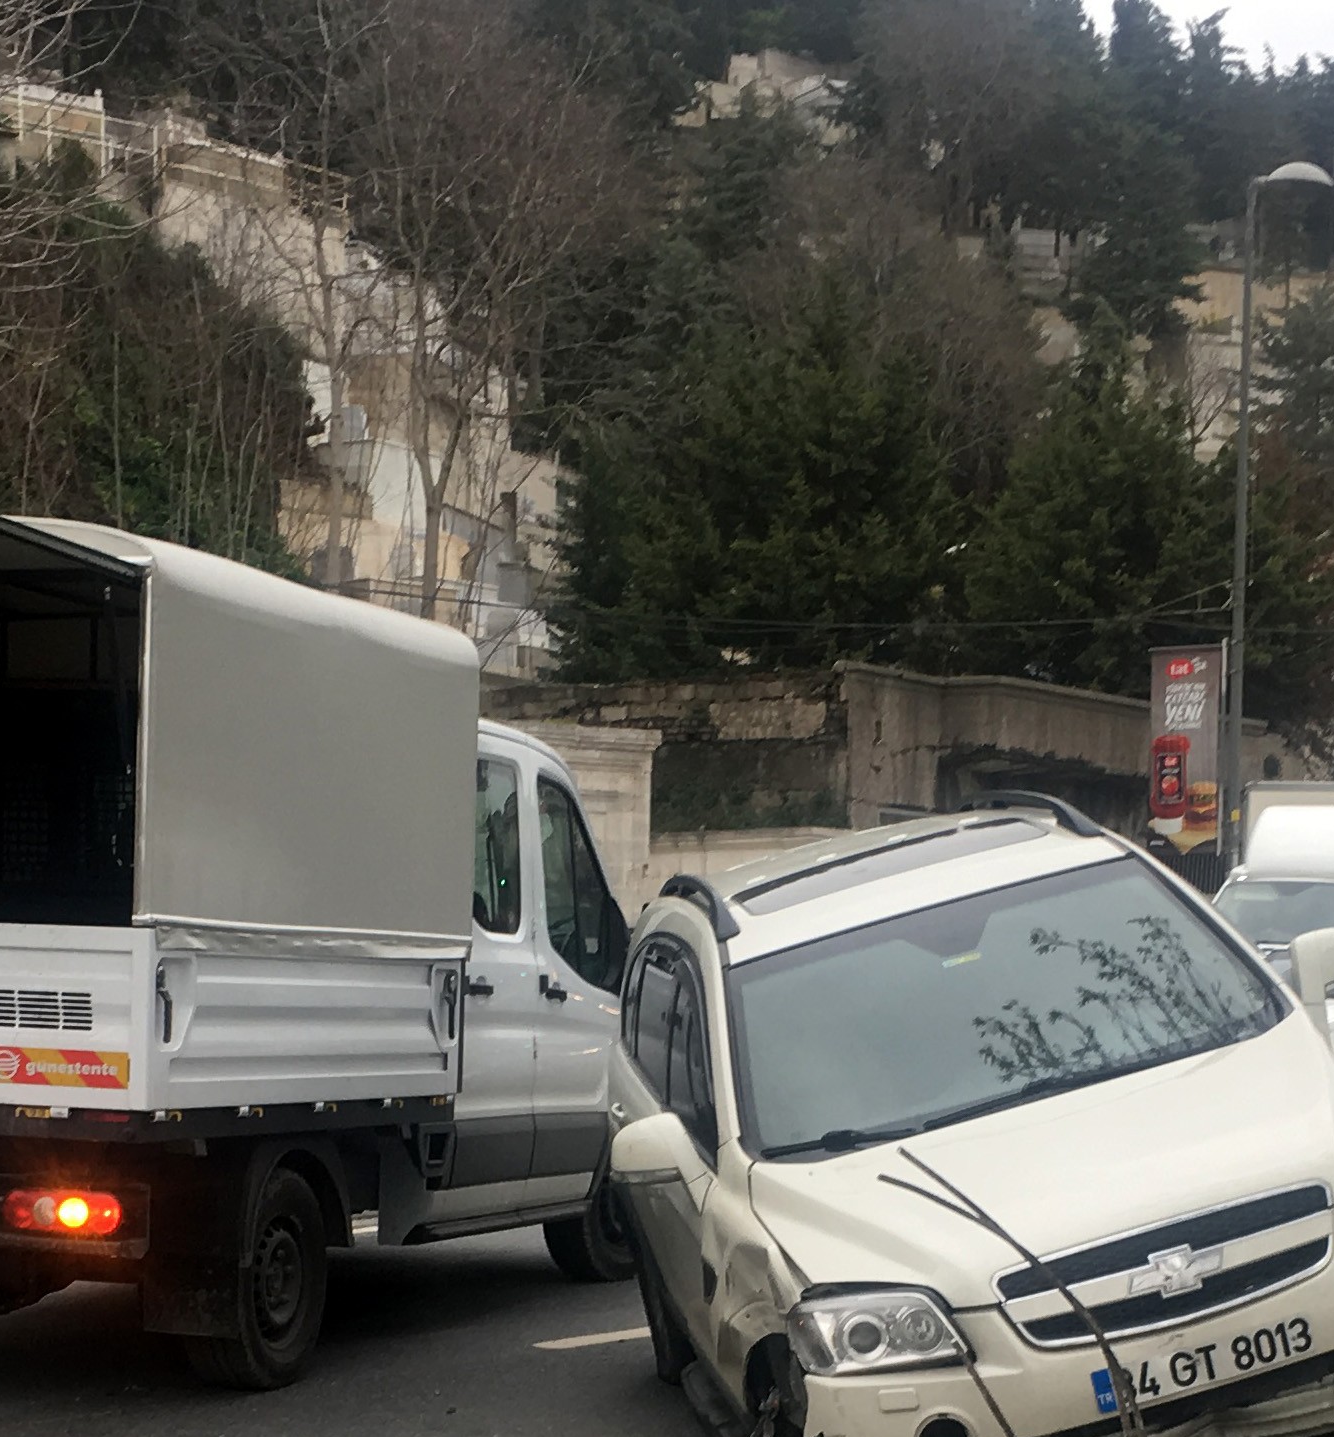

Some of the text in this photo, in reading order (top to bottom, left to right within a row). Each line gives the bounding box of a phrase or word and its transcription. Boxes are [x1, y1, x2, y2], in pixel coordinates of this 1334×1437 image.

[1097, 1392, 1114, 1406] TR
[1169, 1342, 1217, 1388] GT
[1231, 1317, 1313, 1371] 8013
